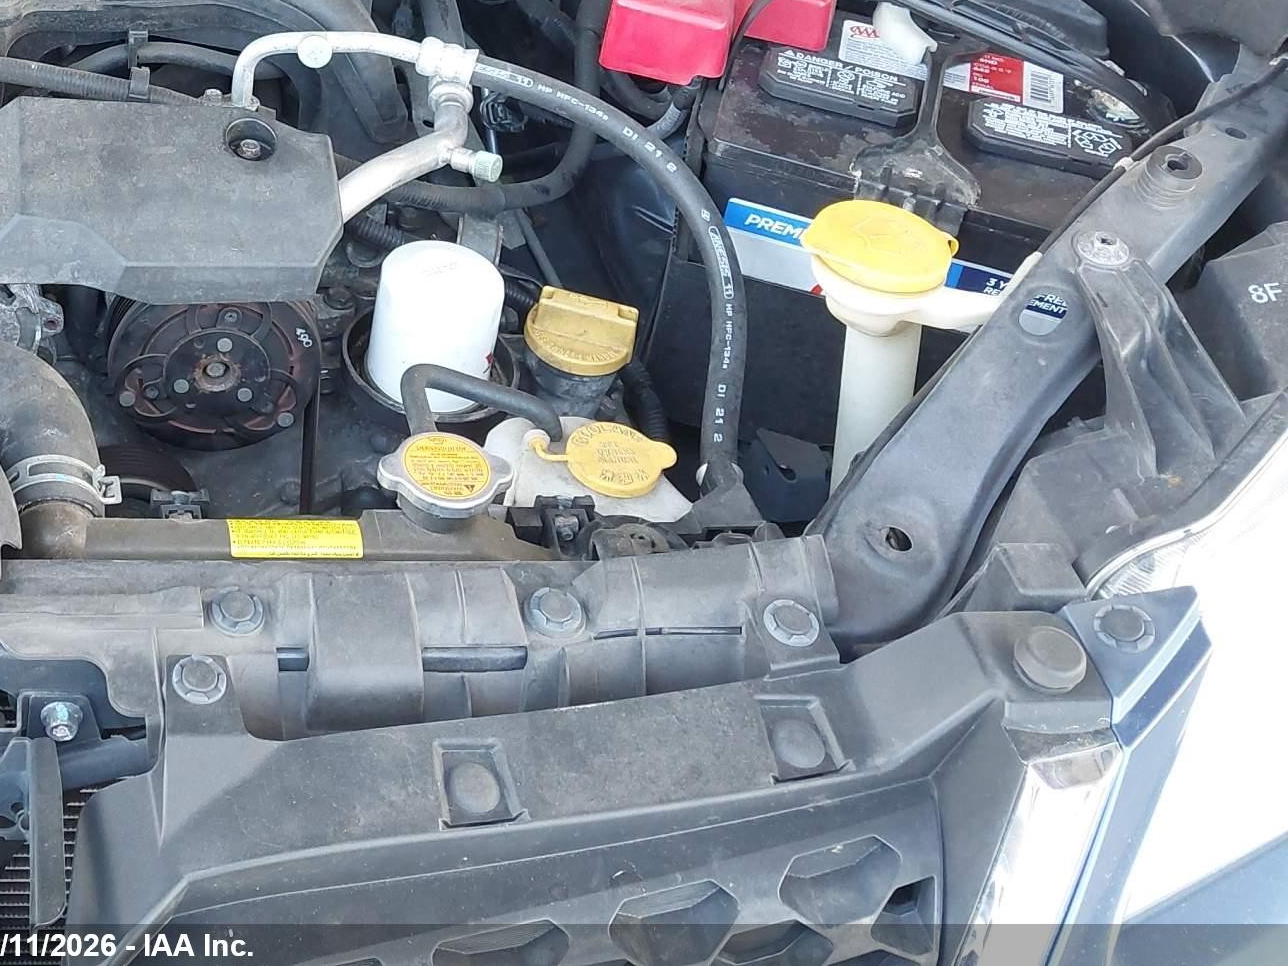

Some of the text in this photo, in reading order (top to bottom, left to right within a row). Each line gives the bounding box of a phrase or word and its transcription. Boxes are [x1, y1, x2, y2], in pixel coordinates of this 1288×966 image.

[795, 51, 843, 70] DANGER
[855, 65, 899, 83] POISON
[986, 277, 998, 287] 3
[1247, 281, 1283, 304] 8F
